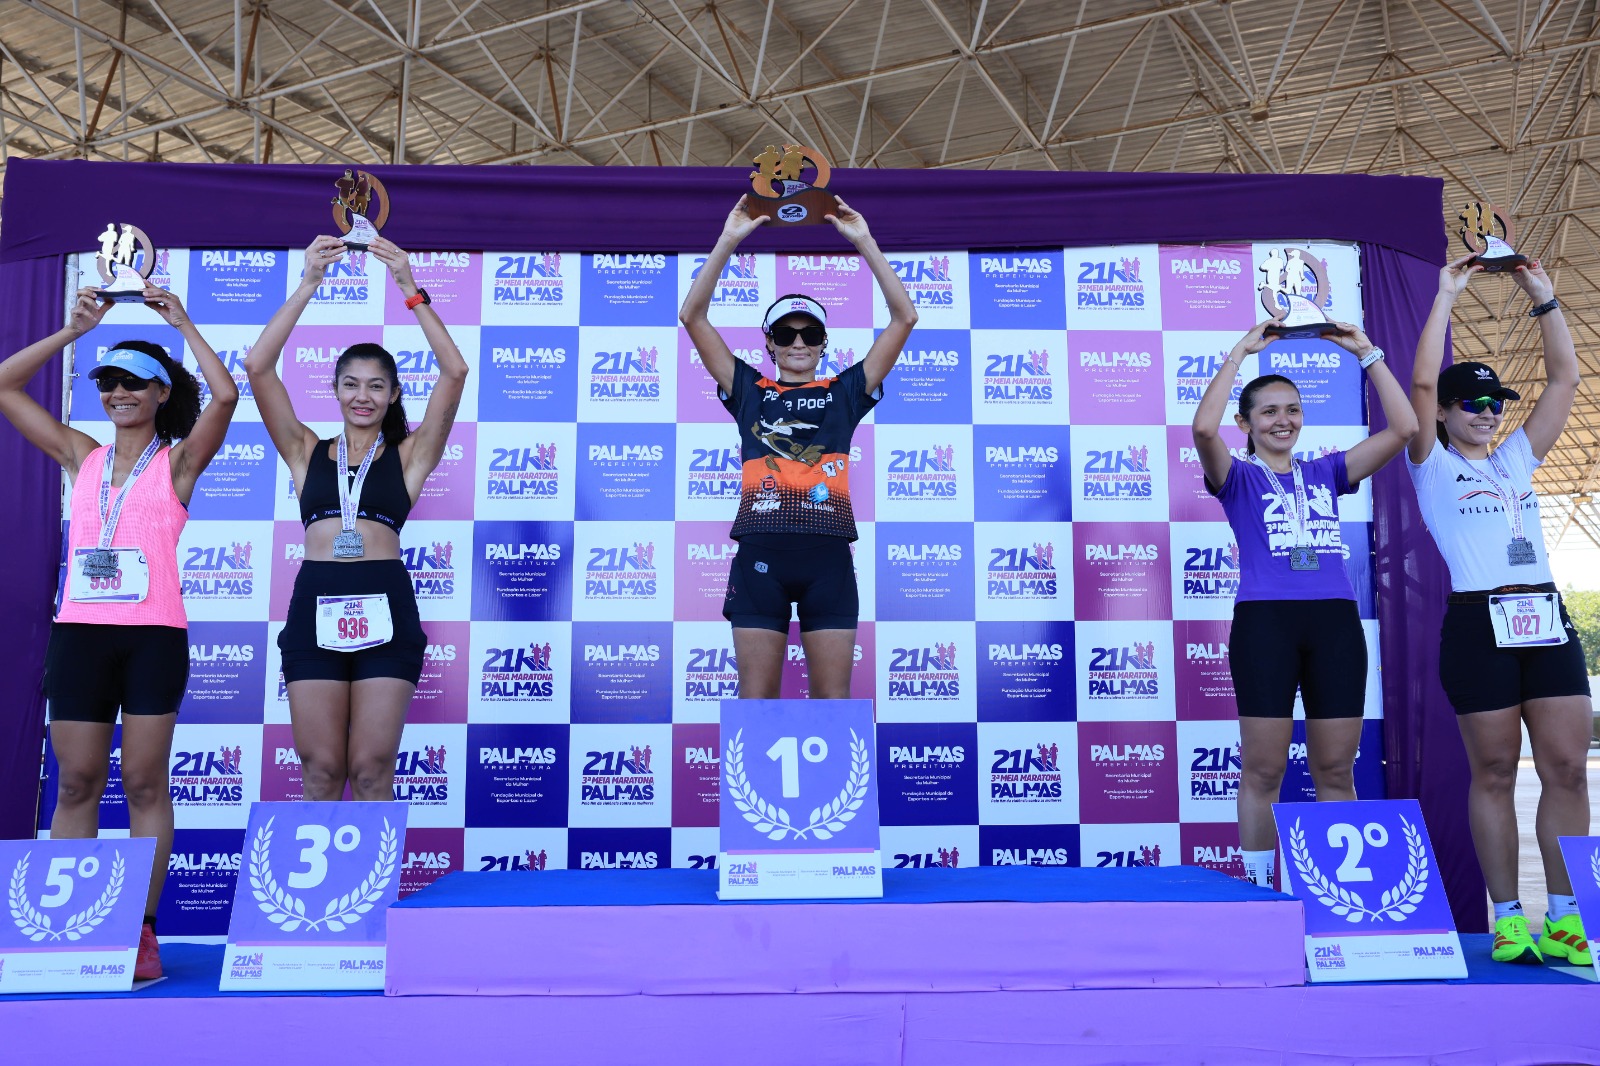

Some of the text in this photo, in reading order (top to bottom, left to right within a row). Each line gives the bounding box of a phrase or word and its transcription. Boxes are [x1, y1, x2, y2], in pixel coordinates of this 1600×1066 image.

[202, 251, 275, 267] PALMAS
[981, 258, 1052, 273] PALMAS
[1171, 259, 1241, 274] PALMAS
[495, 256, 562, 278] 21K
[1078, 262, 1144, 283] 21K
[495, 287, 562, 301] PALMAS
[1078, 292, 1144, 306] PALMAS
[493, 348, 565, 363] PALMAS
[590, 352, 658, 374] 21K
[1080, 352, 1151, 367] PALMAS
[984, 354, 1052, 376] 21K
[993, 378, 1011, 386] MEIA
[1012, 378, 1052, 386] MARATONA
[590, 383, 659, 397] PALMAS
[984, 386, 1052, 399] PALMAS
[488, 448, 558, 471] 21K
[986, 447, 1058, 462] PALMAS
[497, 472, 516, 480] MEIA
[516, 472, 558, 480] MARATONA
[488, 480, 558, 495] PALMAS
[751, 500, 781, 511] KTM
[1459, 502, 1537, 514] VILLAHO
[1269, 530, 1341, 550] PAMAS
[182, 546, 252, 570] 21K
[486, 544, 560, 559] PALMAS
[888, 545, 961, 560] PALMAS
[191, 572, 210, 580] MEIA
[211, 572, 253, 580] MARATONA
[182, 580, 252, 595] PALMAS
[338, 617, 368, 639] 936
[1512, 615, 1540, 636] 027
[482, 648, 552, 672] 21K
[585, 645, 659, 661] PALMAS
[1089, 648, 1158, 671] 21K
[1098, 672, 1116, 680] MEIA
[1117, 672, 1157, 680] MARATONA
[482, 682, 553, 696] PALMAS
[1089, 680, 1158, 695] PALMAS
[480, 748, 556, 764] PALMAS
[1091, 745, 1164, 761] PALMAS
[169, 752, 242, 776] 21K
[582, 752, 654, 775] 21K
[766, 736, 828, 798] 1º
[991, 750, 1060, 773] 21K
[180, 776, 198, 786] MEIA
[199, 776, 242, 786] MARATONA
[592, 776, 610, 784] MEIA
[611, 776, 654, 784] MARATONA
[1000, 774, 1019, 782] MEIA
[1020, 774, 1061, 782] MARATONA
[169, 786, 242, 801] PALMAS
[582, 785, 654, 800] PALMAS
[991, 782, 1061, 798] PALMAS
[288, 825, 360, 888] 3º
[993, 849, 1067, 865] PALMAS
[1327, 822, 1388, 882] 2º
[168, 853, 242, 870] PALMAS
[581, 852, 657, 868] PALMAS
[729, 864, 758, 874] 21K
[832, 866, 875, 875] PALMAS
[40, 856, 99, 907] 5º
[1315, 947, 1342, 957] 21K
[1413, 946, 1454, 956] PALMAS
[232, 955, 263, 966] 21K
[339, 960, 384, 969] PALMAS
[80, 965, 125, 975] PALMAS
